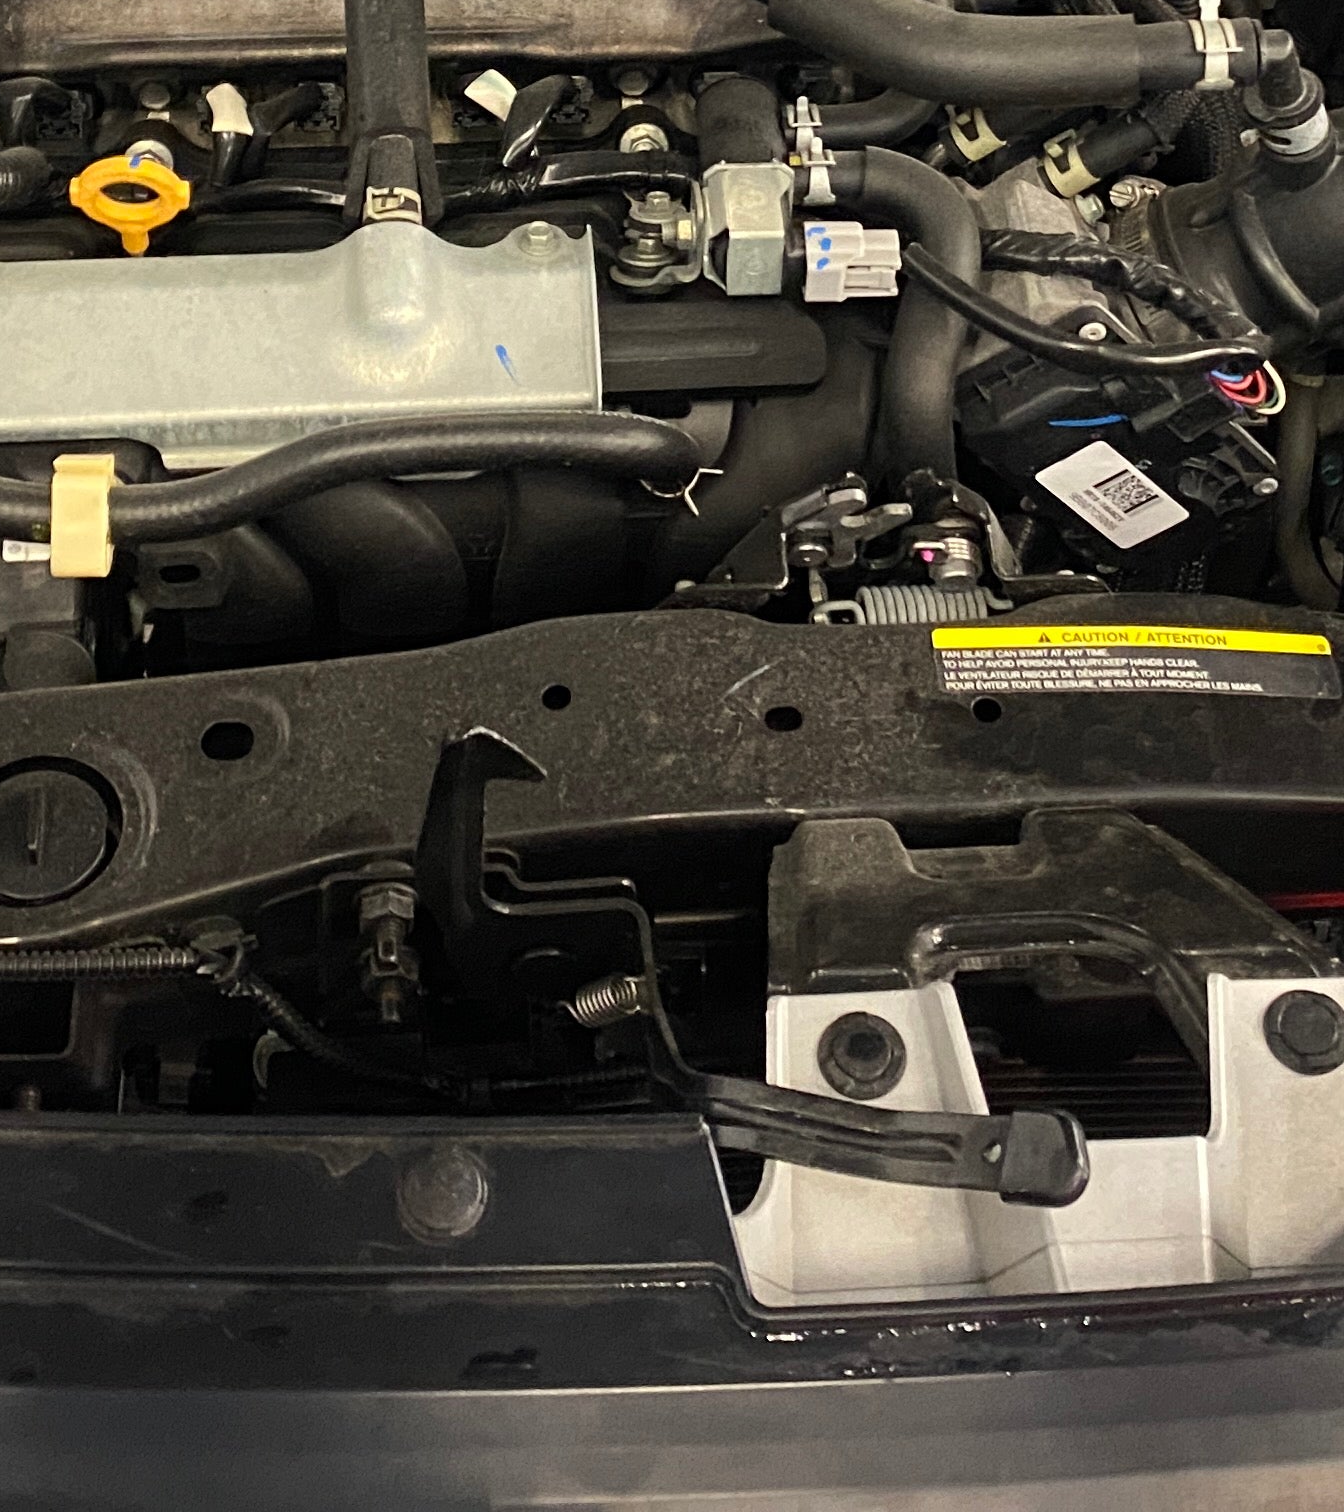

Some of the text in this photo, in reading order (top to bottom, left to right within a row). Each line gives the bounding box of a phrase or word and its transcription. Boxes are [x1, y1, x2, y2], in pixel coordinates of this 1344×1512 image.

[1061, 631, 1228, 646] CAUTION / ATTENTION
[942, 649, 961, 659] FAN
[995, 649, 1018, 658] CAN
[1019, 649, 1049, 658] START
[1050, 648, 1063, 657] AT
[1064, 648, 1084, 657] ANY
[943, 659, 957, 669] TO
[958, 659, 983, 668] HELP
[985, 659, 1015, 668] AVOID
[1016, 658, 1069, 668] PERSONAL
[1129, 658, 1164, 667] HANDS
[944, 671, 956, 681] LE
[957, 670, 1021, 680] VENTILATEUR
[1022, 669, 1060, 680] RISQUE
[1061, 670, 1075, 679] DE
[1141, 669, 1165, 678] TOUT
[946, 681, 975, 690] POUR
[1011, 680, 1043, 689] TOUTE
[1099, 679, 1112, 688] NE
[1113, 679, 1133, 688] PAS
[1135, 679, 1149, 688] EN
[1150, 680, 1210, 690] APPROCHER
[1211, 681, 1231, 691] LES
